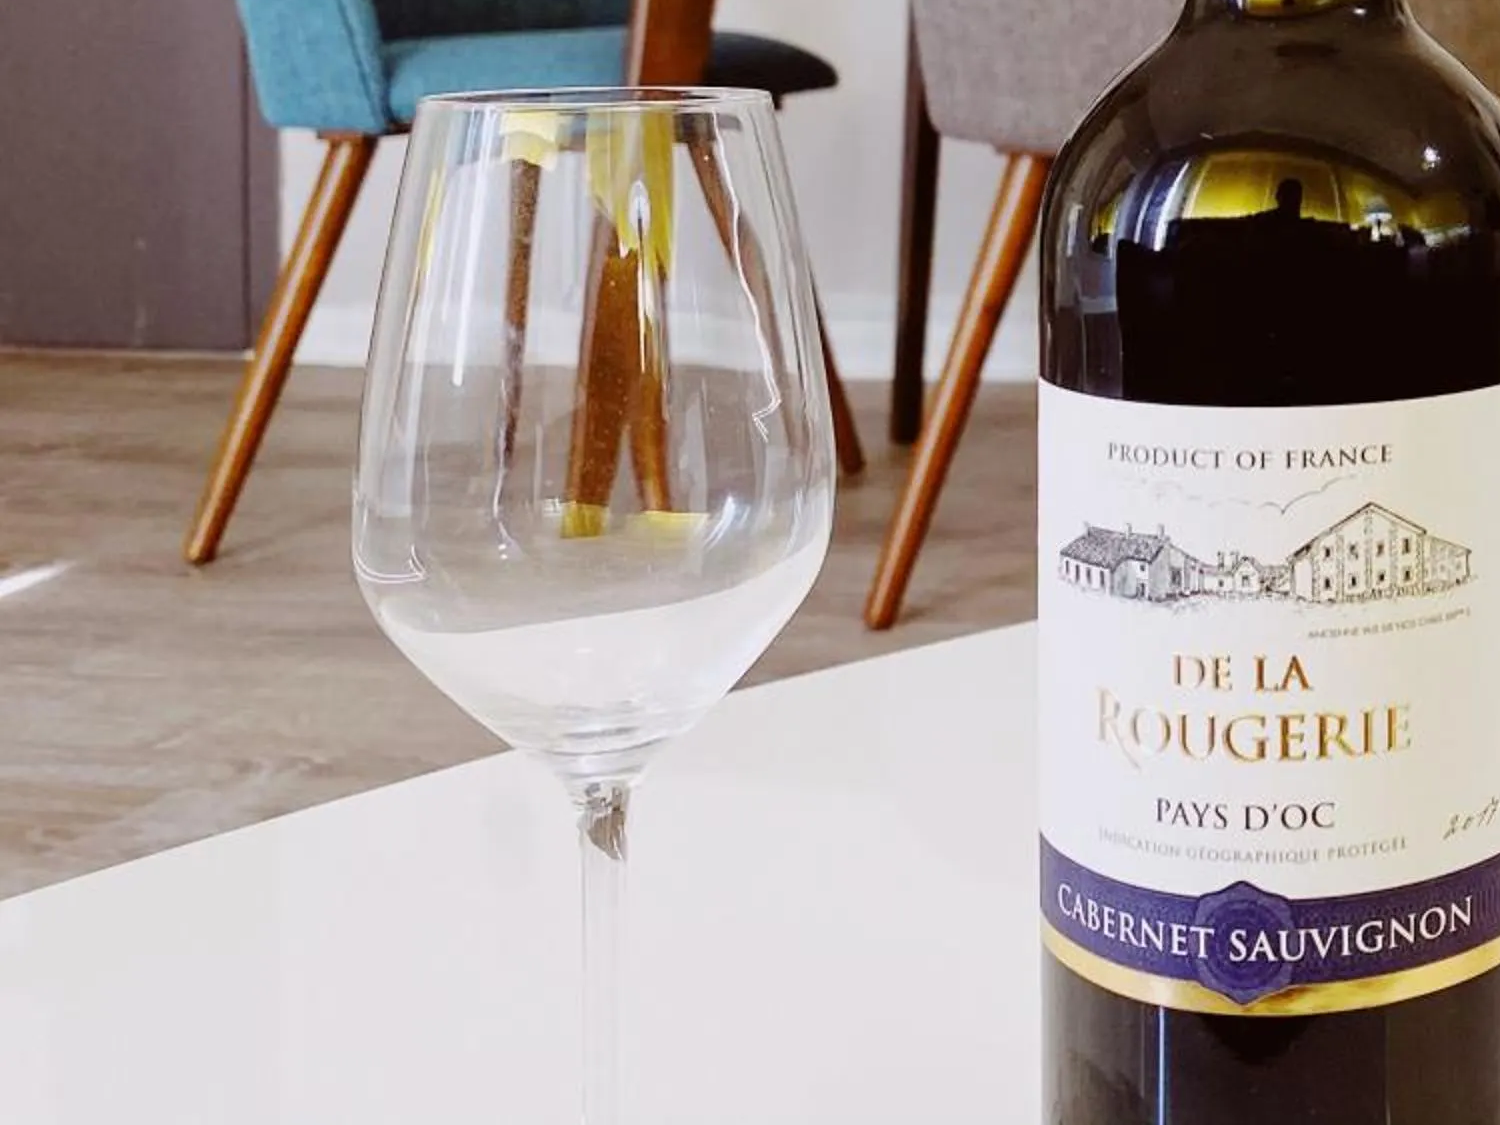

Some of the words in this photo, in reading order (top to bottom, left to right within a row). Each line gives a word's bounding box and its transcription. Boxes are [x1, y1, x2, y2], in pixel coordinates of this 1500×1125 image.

[1107, 441, 1225, 470] PRODUCT
[1236, 450, 1273, 470] OF
[1285, 442, 1394, 470] FRANCE
[1173, 654, 1233, 692] DE
[1254, 654, 1315, 693] LA
[1096, 686, 1412, 772] ROUGERIE
[1155, 797, 1228, 831] PAYS
[1243, 801, 1337, 832] D'OC
[1099, 826, 1181, 858] INDICATION
[1057, 884, 1215, 960] CABERNET
[1229, 895, 1474, 963] SAUVIGNON
